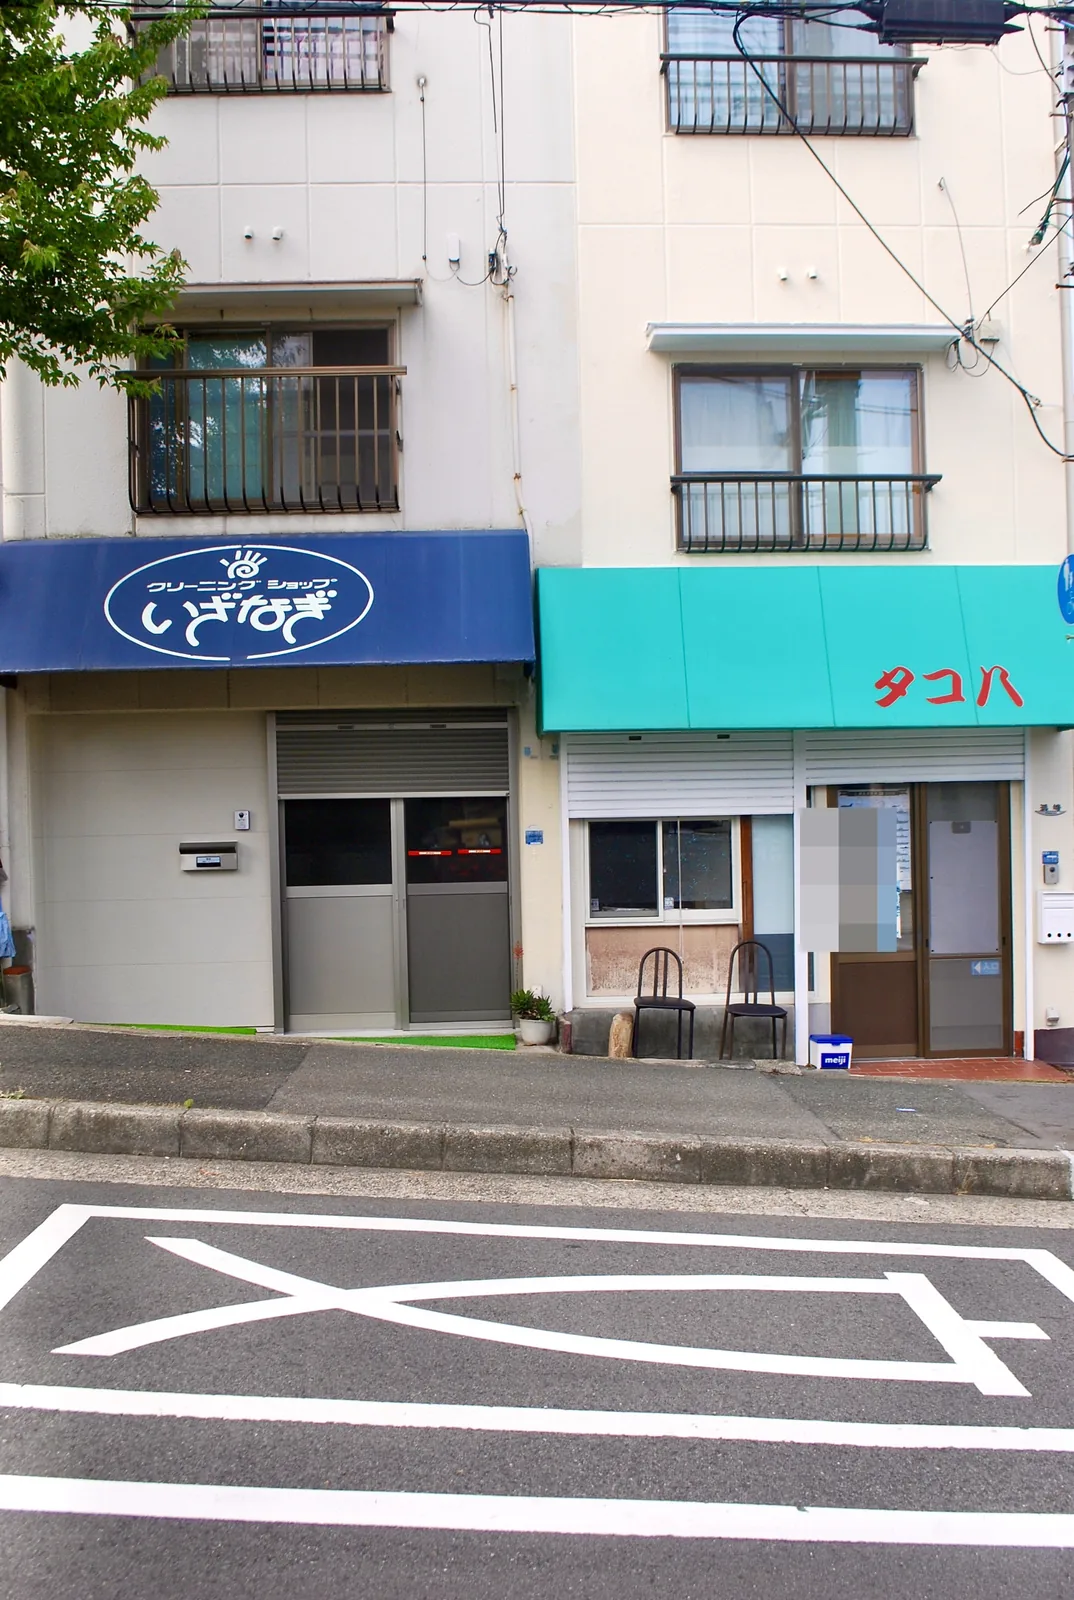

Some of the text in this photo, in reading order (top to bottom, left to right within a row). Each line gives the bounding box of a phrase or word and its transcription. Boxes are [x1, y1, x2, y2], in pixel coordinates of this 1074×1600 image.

[146, 578, 338, 593] クリーニング ショップ
[141, 589, 338, 647] いざなぎ
[824, 1055, 846, 1065] meiji
